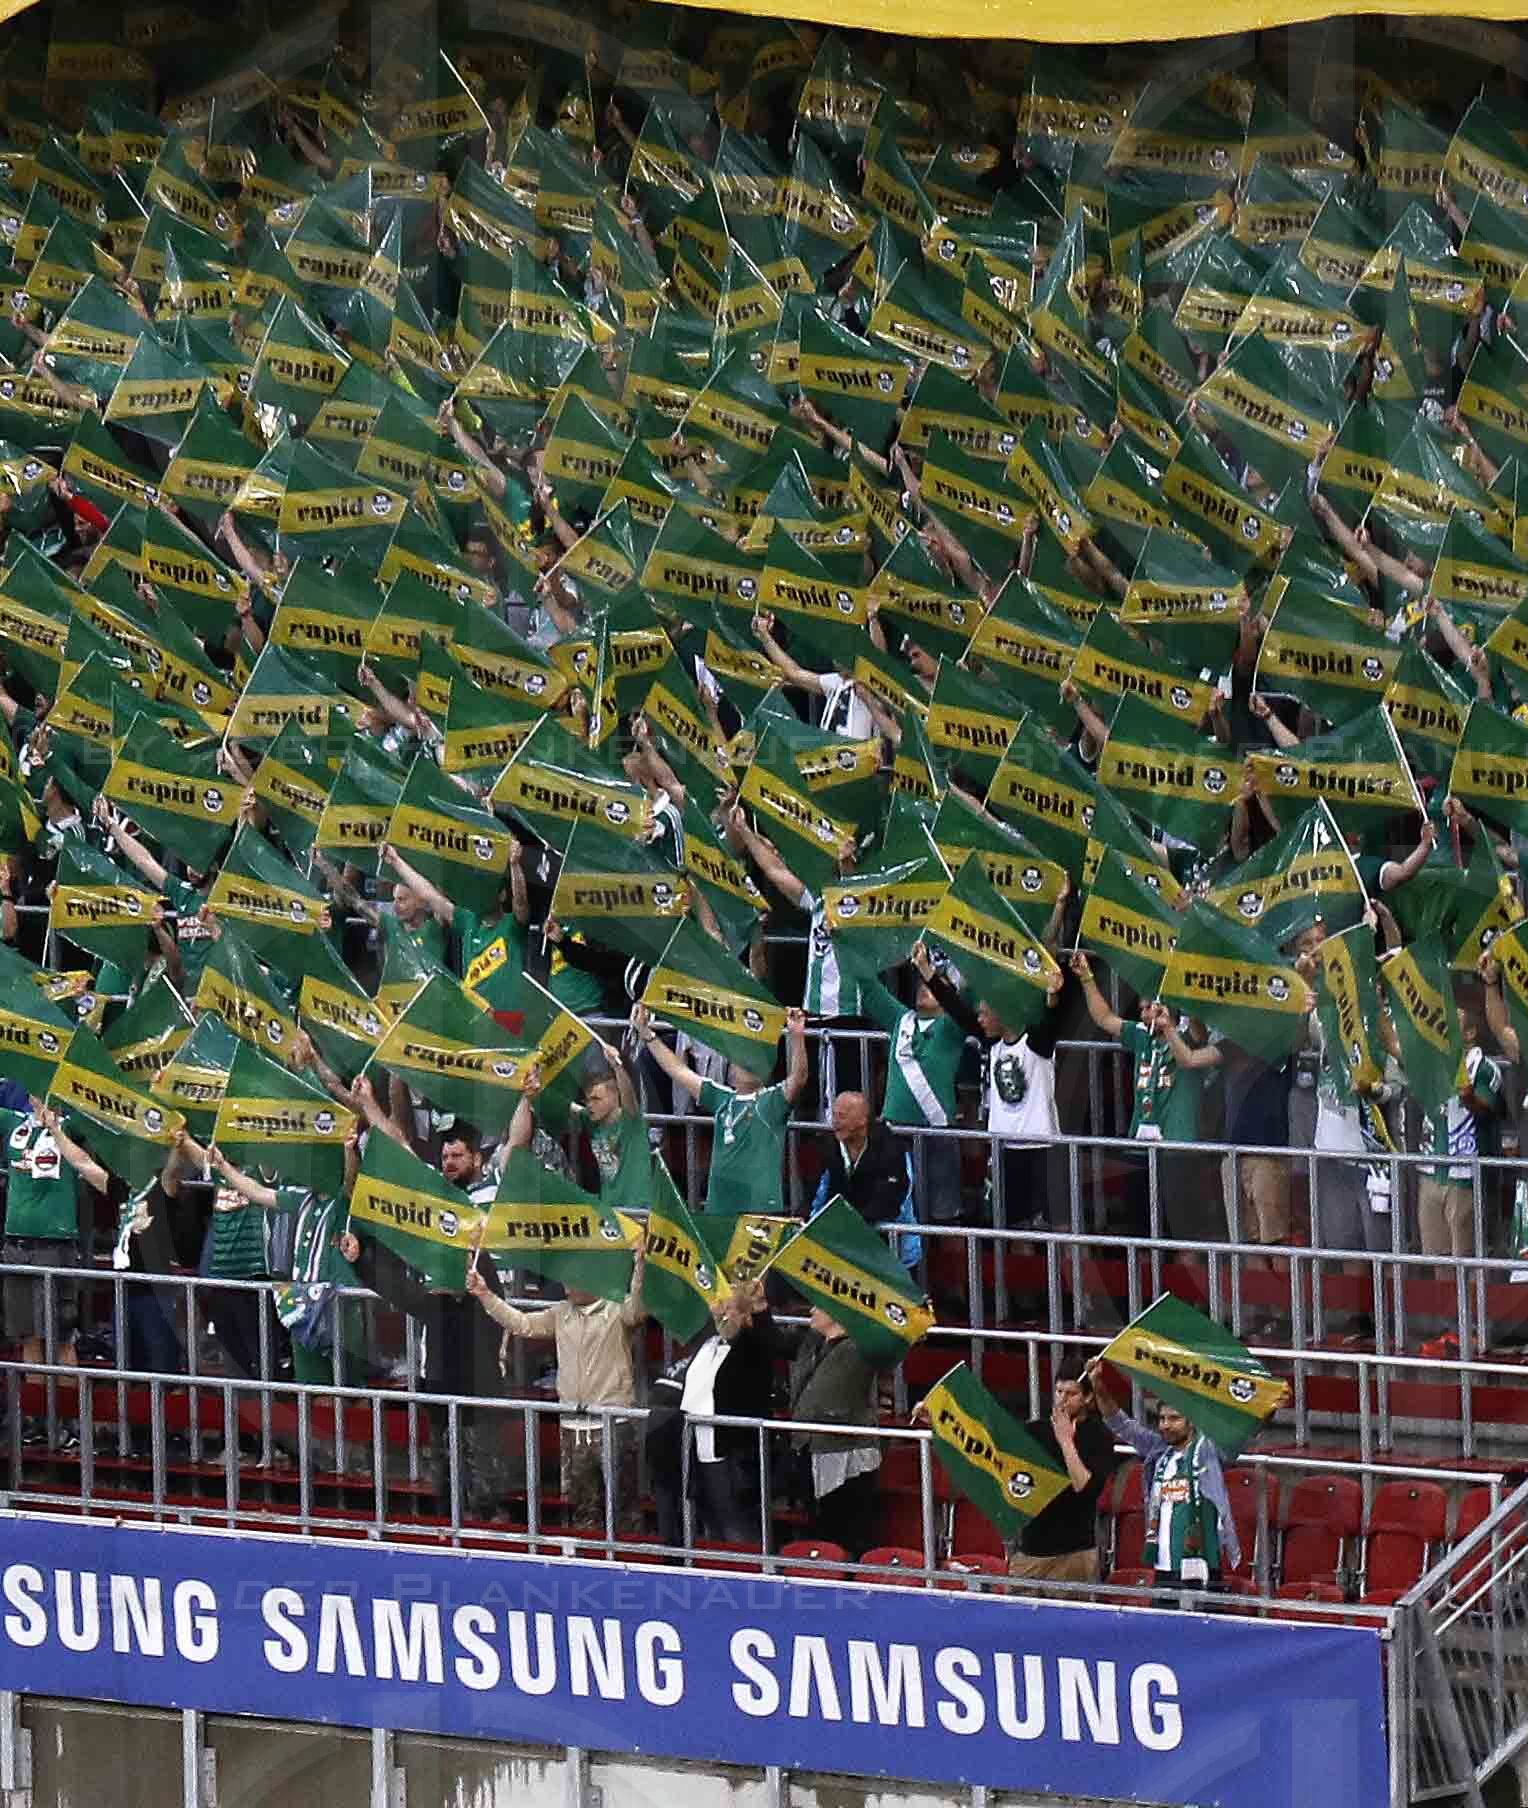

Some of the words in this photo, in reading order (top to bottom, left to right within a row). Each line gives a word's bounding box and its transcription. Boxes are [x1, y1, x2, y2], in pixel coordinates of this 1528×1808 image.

[296, 497, 363, 524] rapid
[1180, 475, 1240, 520] rapid
[1182, 481, 1242, 523] rapid
[149, 555, 210, 585] rapid
[664, 571, 730, 596] rapid
[775, 579, 835, 606] rapid
[289, 622, 363, 647] rapid
[1278, 645, 1353, 674] rapid
[1093, 661, 1166, 696] rapid
[943, 722, 1008, 748] rapid
[128, 774, 196, 808] rapid
[1115, 762, 1191, 790] rapid
[517, 780, 597, 817] rapid
[1010, 780, 1078, 817] rapid
[408, 821, 469, 852] rapid
[572, 885, 644, 909] rapid
[950, 908, 1016, 960] rapid
[951, 915, 1014, 954] rapid
[1097, 915, 1169, 948] rapid
[1183, 965, 1259, 997] rapid
[70, 1077, 134, 1121] rapid
[367, 1192, 433, 1227] rapid
[506, 1216, 590, 1243] rapid
[799, 1255, 878, 1313] rapid
[263, 1587, 684, 1706] SAMSUNG
[731, 1628, 1183, 1752] SAMSUNG
